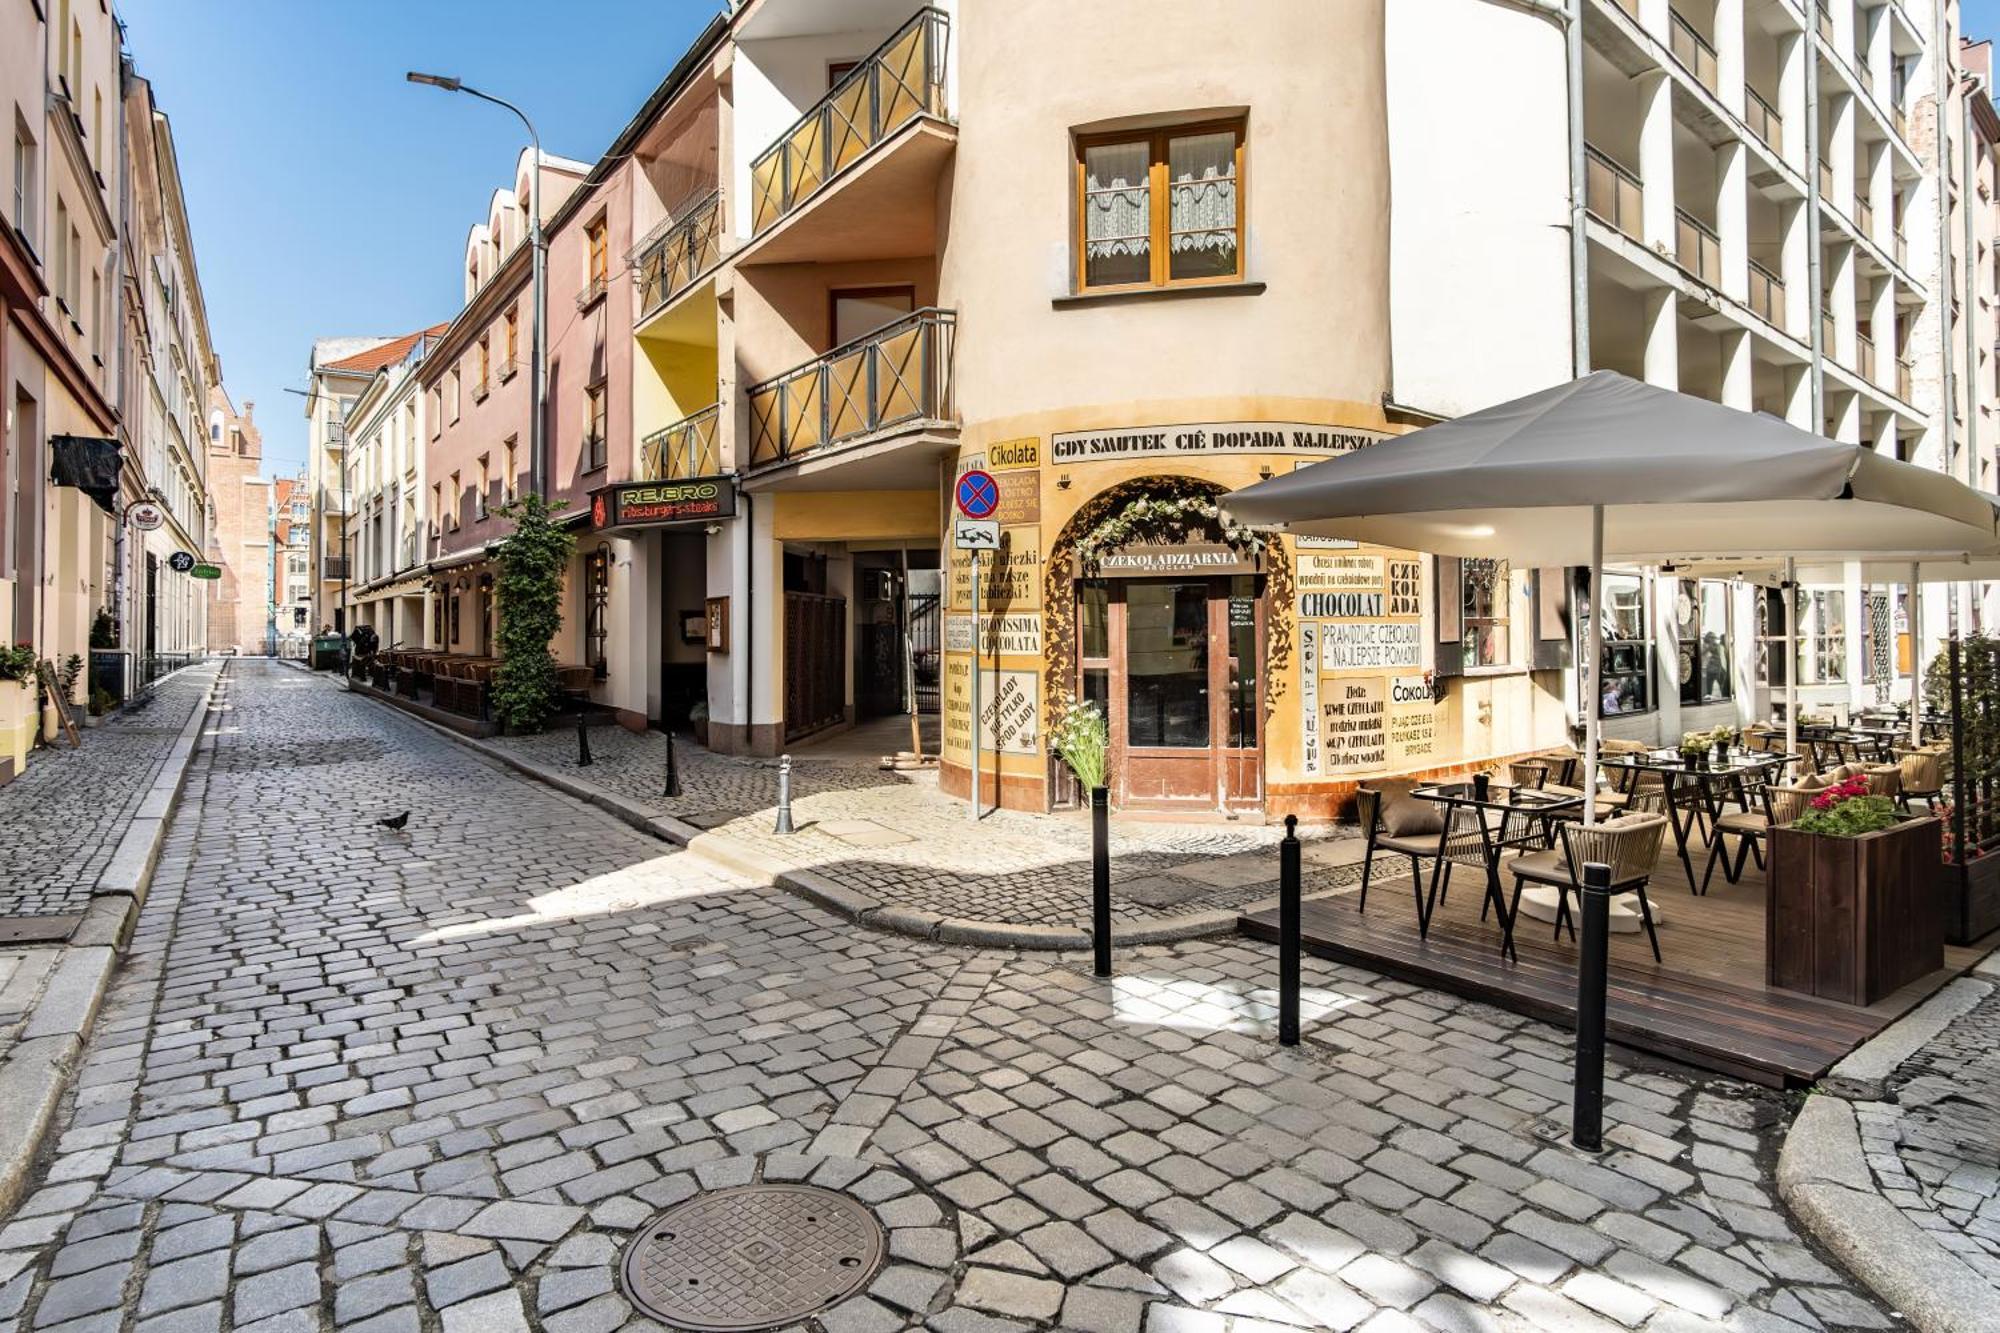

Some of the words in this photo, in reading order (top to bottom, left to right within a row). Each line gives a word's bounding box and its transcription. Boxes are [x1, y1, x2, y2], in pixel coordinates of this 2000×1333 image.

[991, 444, 1037, 466] Cikolata
[1054, 439, 1087, 457] GDY
[1090, 434, 1167, 454] SMUTEK
[1212, 431, 1286, 449] DOPADA
[1292, 431, 1373, 450] NAJLEPSZA
[1100, 552, 1239, 568] CZEKOLADZIARNIA
[1390, 563, 1420, 580] CZE
[1390, 580, 1420, 597] KOL
[1301, 592, 1383, 617] CHOCOLAT
[1390, 597, 1420, 614] ADA
[980, 675, 1019, 725] CZEKOLADY
[990, 717, 1004, 737] NIE
[1000, 692, 1025, 721] TYLKO
[996, 724, 1017, 750] SPOD
[1014, 701, 1036, 728] LADY
